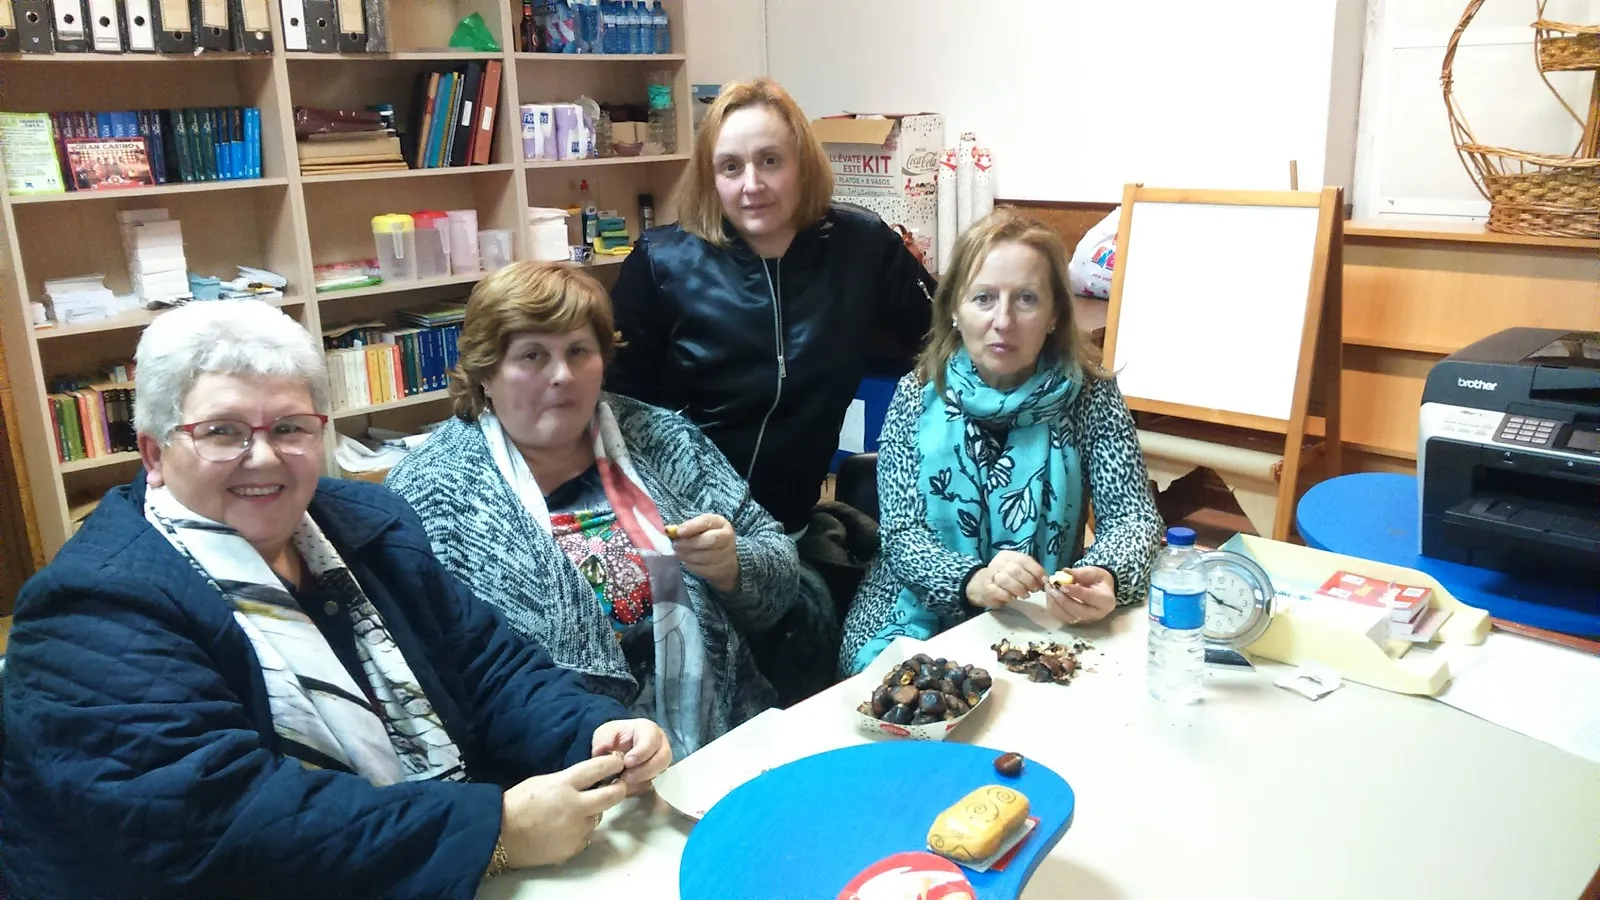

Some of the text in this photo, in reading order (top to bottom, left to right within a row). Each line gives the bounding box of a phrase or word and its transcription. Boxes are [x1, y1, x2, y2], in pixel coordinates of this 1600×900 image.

[830, 154, 861, 164] LLÉVATE
[844, 155, 892, 174] ESTE KIT
[1457, 377, 1498, 391] brother
[1218, 576, 1225, 584] 12
